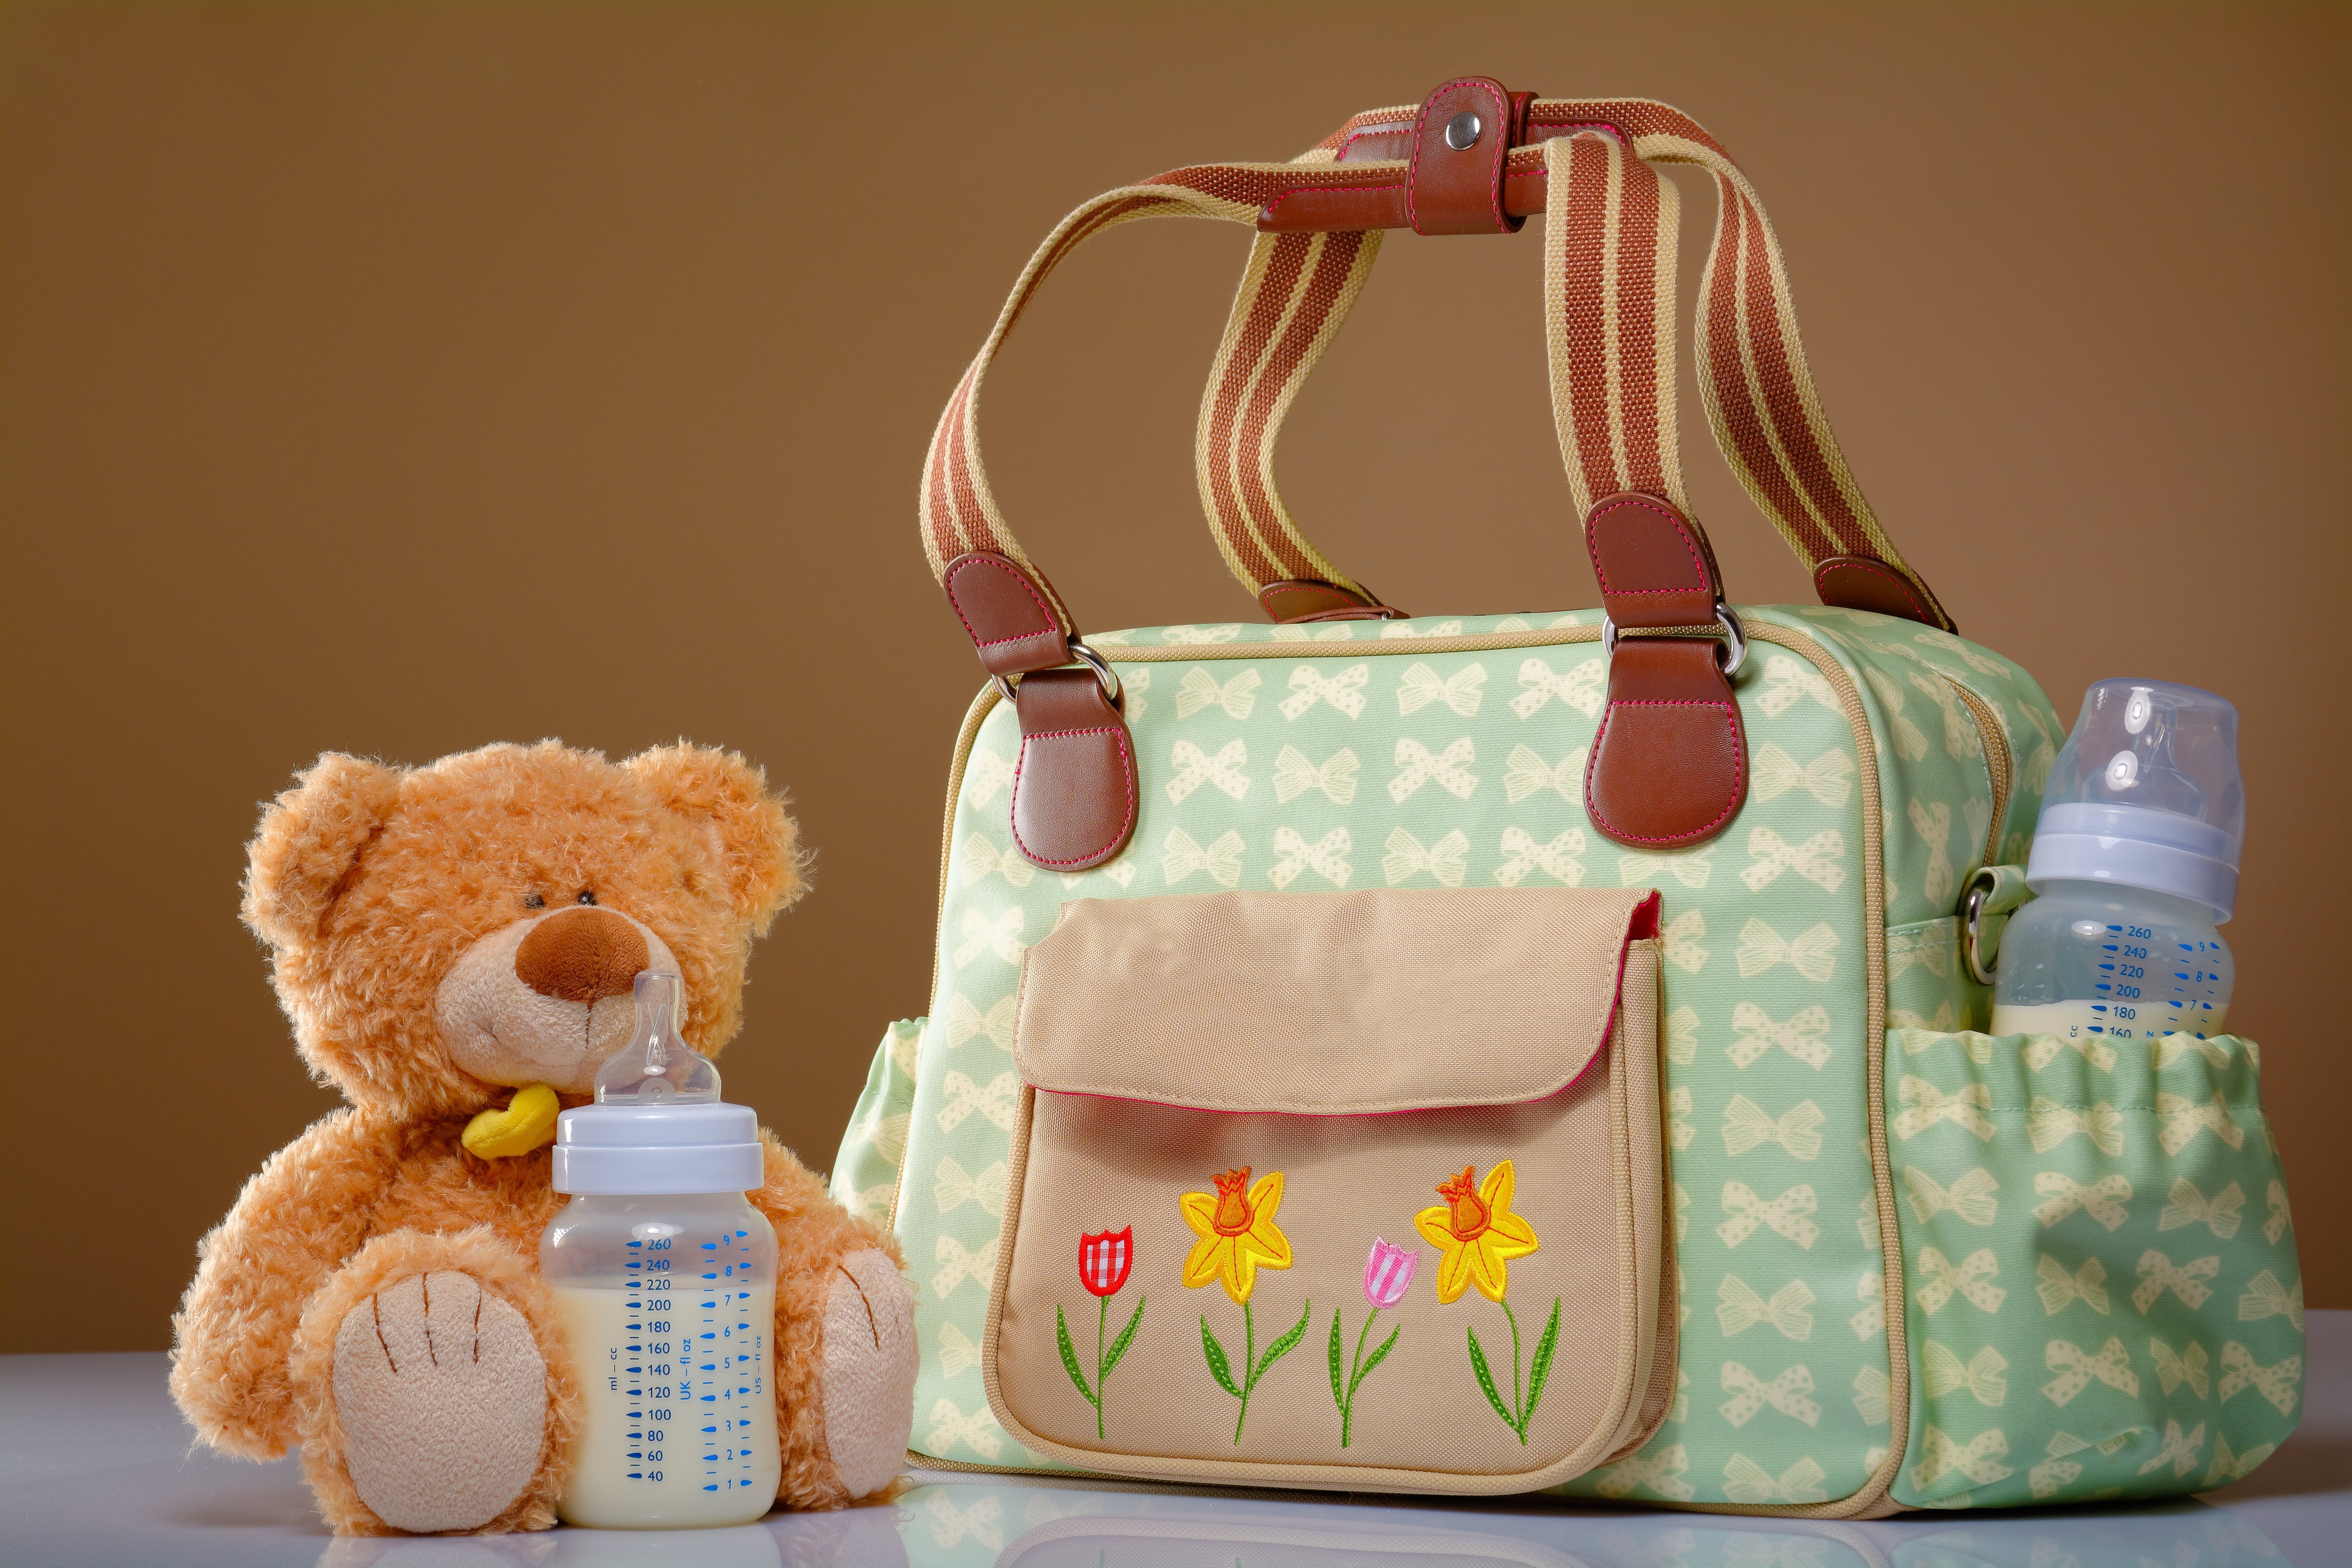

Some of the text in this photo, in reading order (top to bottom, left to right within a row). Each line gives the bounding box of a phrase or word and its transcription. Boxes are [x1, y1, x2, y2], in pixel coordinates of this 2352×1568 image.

[2127, 925, 2152, 939] 260
[2123, 944, 2147, 959] 240
[2199, 941, 2205, 952] 9
[2119, 964, 2144, 979] 220
[2196, 971, 2203, 982] 8
[2116, 984, 2140, 999] 200
[2190, 999, 2197, 1010] 7
[2113, 1006, 2136, 1020] 180
[2070, 1025, 2078, 1038] cc
[650, 1087, 663, 1103] 2
[647, 1238, 671, 1250] 260
[723, 1234, 730, 1246] 9
[646, 1259, 670, 1271] 240
[725, 1265, 732, 1277] 8
[646, 1279, 670, 1291] 220
[647, 1299, 671, 1311] 200
[725, 1294, 731, 1306] 7
[647, 1321, 670, 1333] 180
[724, 1325, 731, 1338] 6
[647, 1342, 670, 1354] 160
[683, 1338, 691, 1352] oz
[756, 1335, 761, 1349] oz
[610, 1348, 617, 1360] cc
[679, 1357, 691, 1365] fl
[724, 1357, 730, 1369] 5
[648, 1364, 670, 1376] 140
[679, 1380, 691, 1400] UK
[755, 1377, 762, 1394] US
[648, 1386, 670, 1398] 120
[724, 1388, 731, 1400] 4
[648, 1409, 671, 1421] 100
[726, 1420, 731, 1432] 3
[648, 1430, 664, 1442] 80
[648, 1450, 663, 1461] 60
[726, 1449, 733, 1461] 2
[647, 1471, 663, 1482] 40
[727, 1479, 732, 1490] 1
